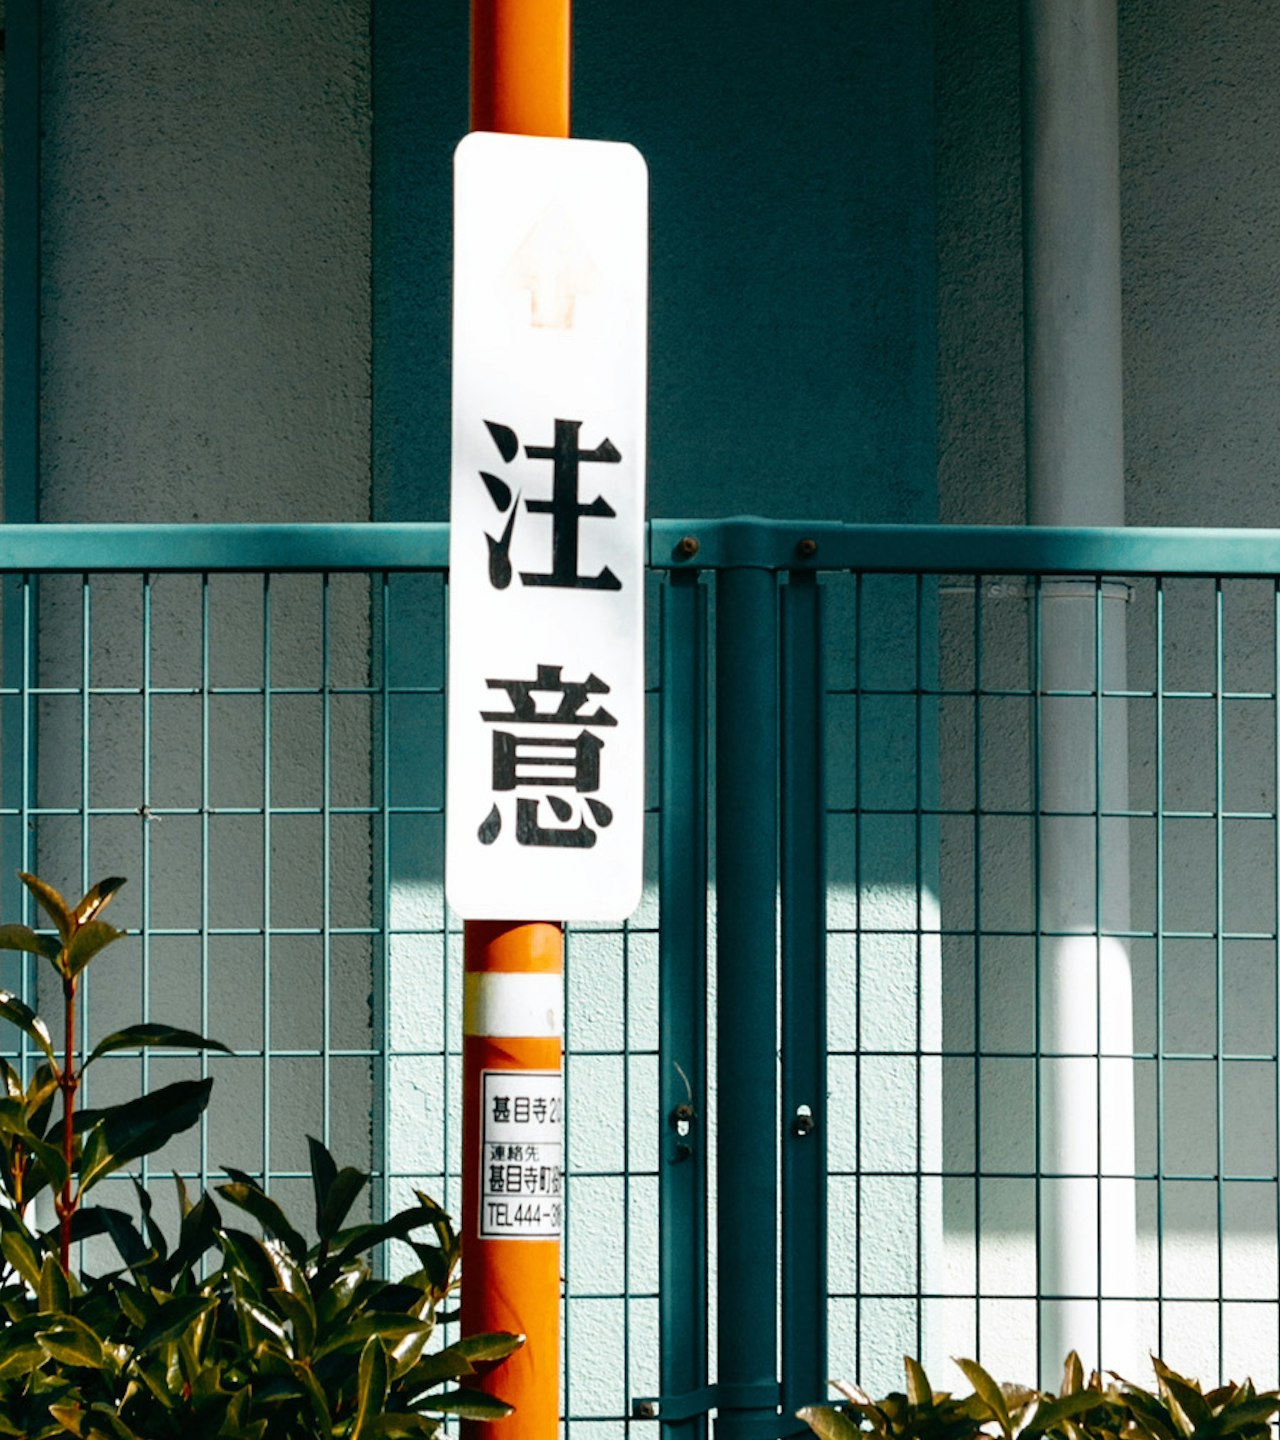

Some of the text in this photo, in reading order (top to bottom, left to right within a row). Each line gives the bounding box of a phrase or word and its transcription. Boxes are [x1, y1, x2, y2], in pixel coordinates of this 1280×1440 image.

[478, 417, 624, 849] 注意
[490, 1145, 540, 1161] 連絡先
